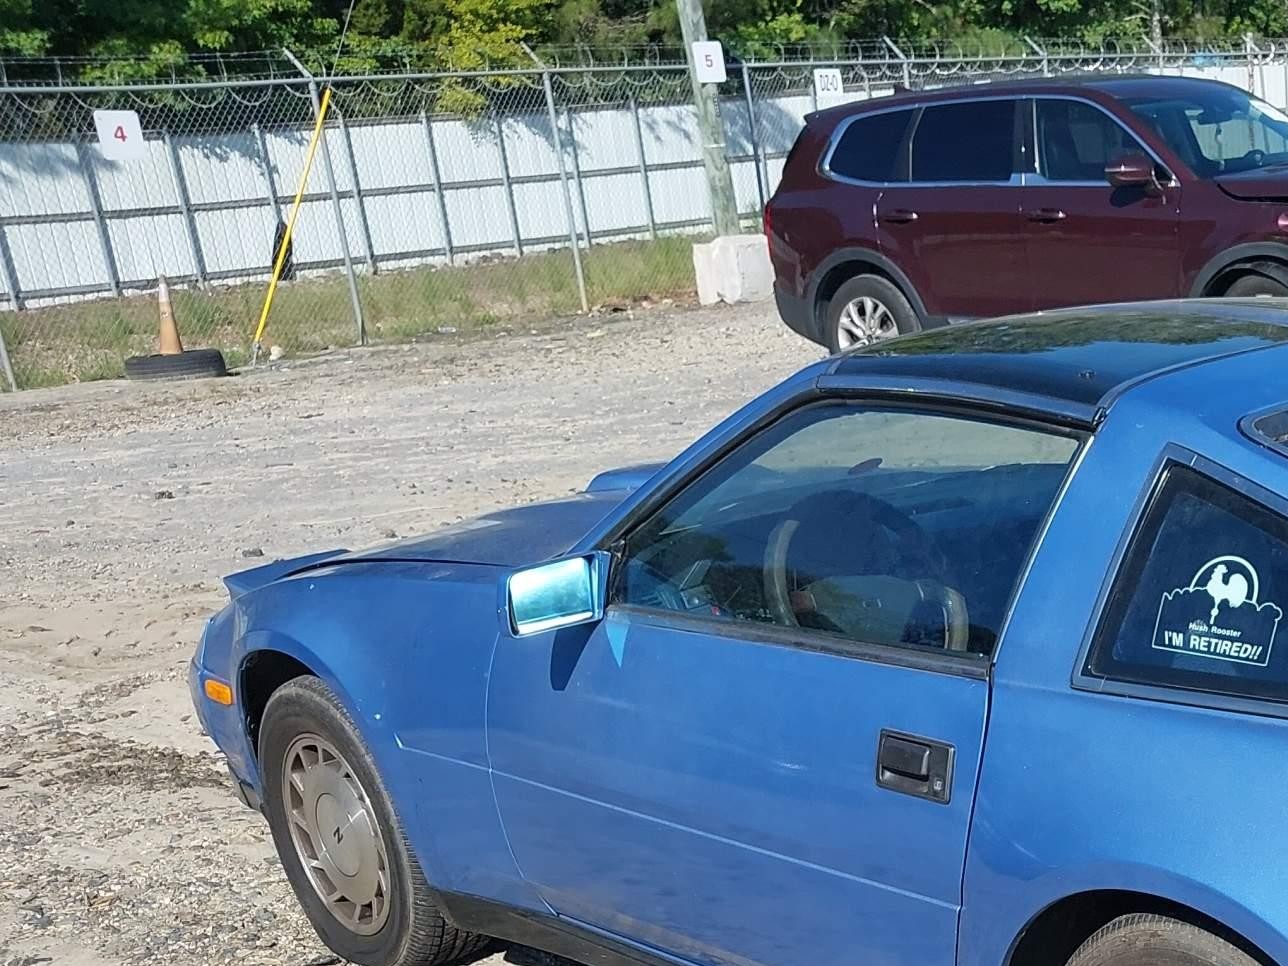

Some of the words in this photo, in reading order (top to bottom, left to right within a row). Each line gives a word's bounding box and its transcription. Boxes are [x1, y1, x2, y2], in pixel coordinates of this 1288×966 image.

[704, 54, 714, 69] 5
[114, 125, 127, 142] 4
[1211, 625, 1242, 638] Rooster
[1164, 630, 1184, 647] I'M
[1189, 634, 1263, 660] RETIRED!!
